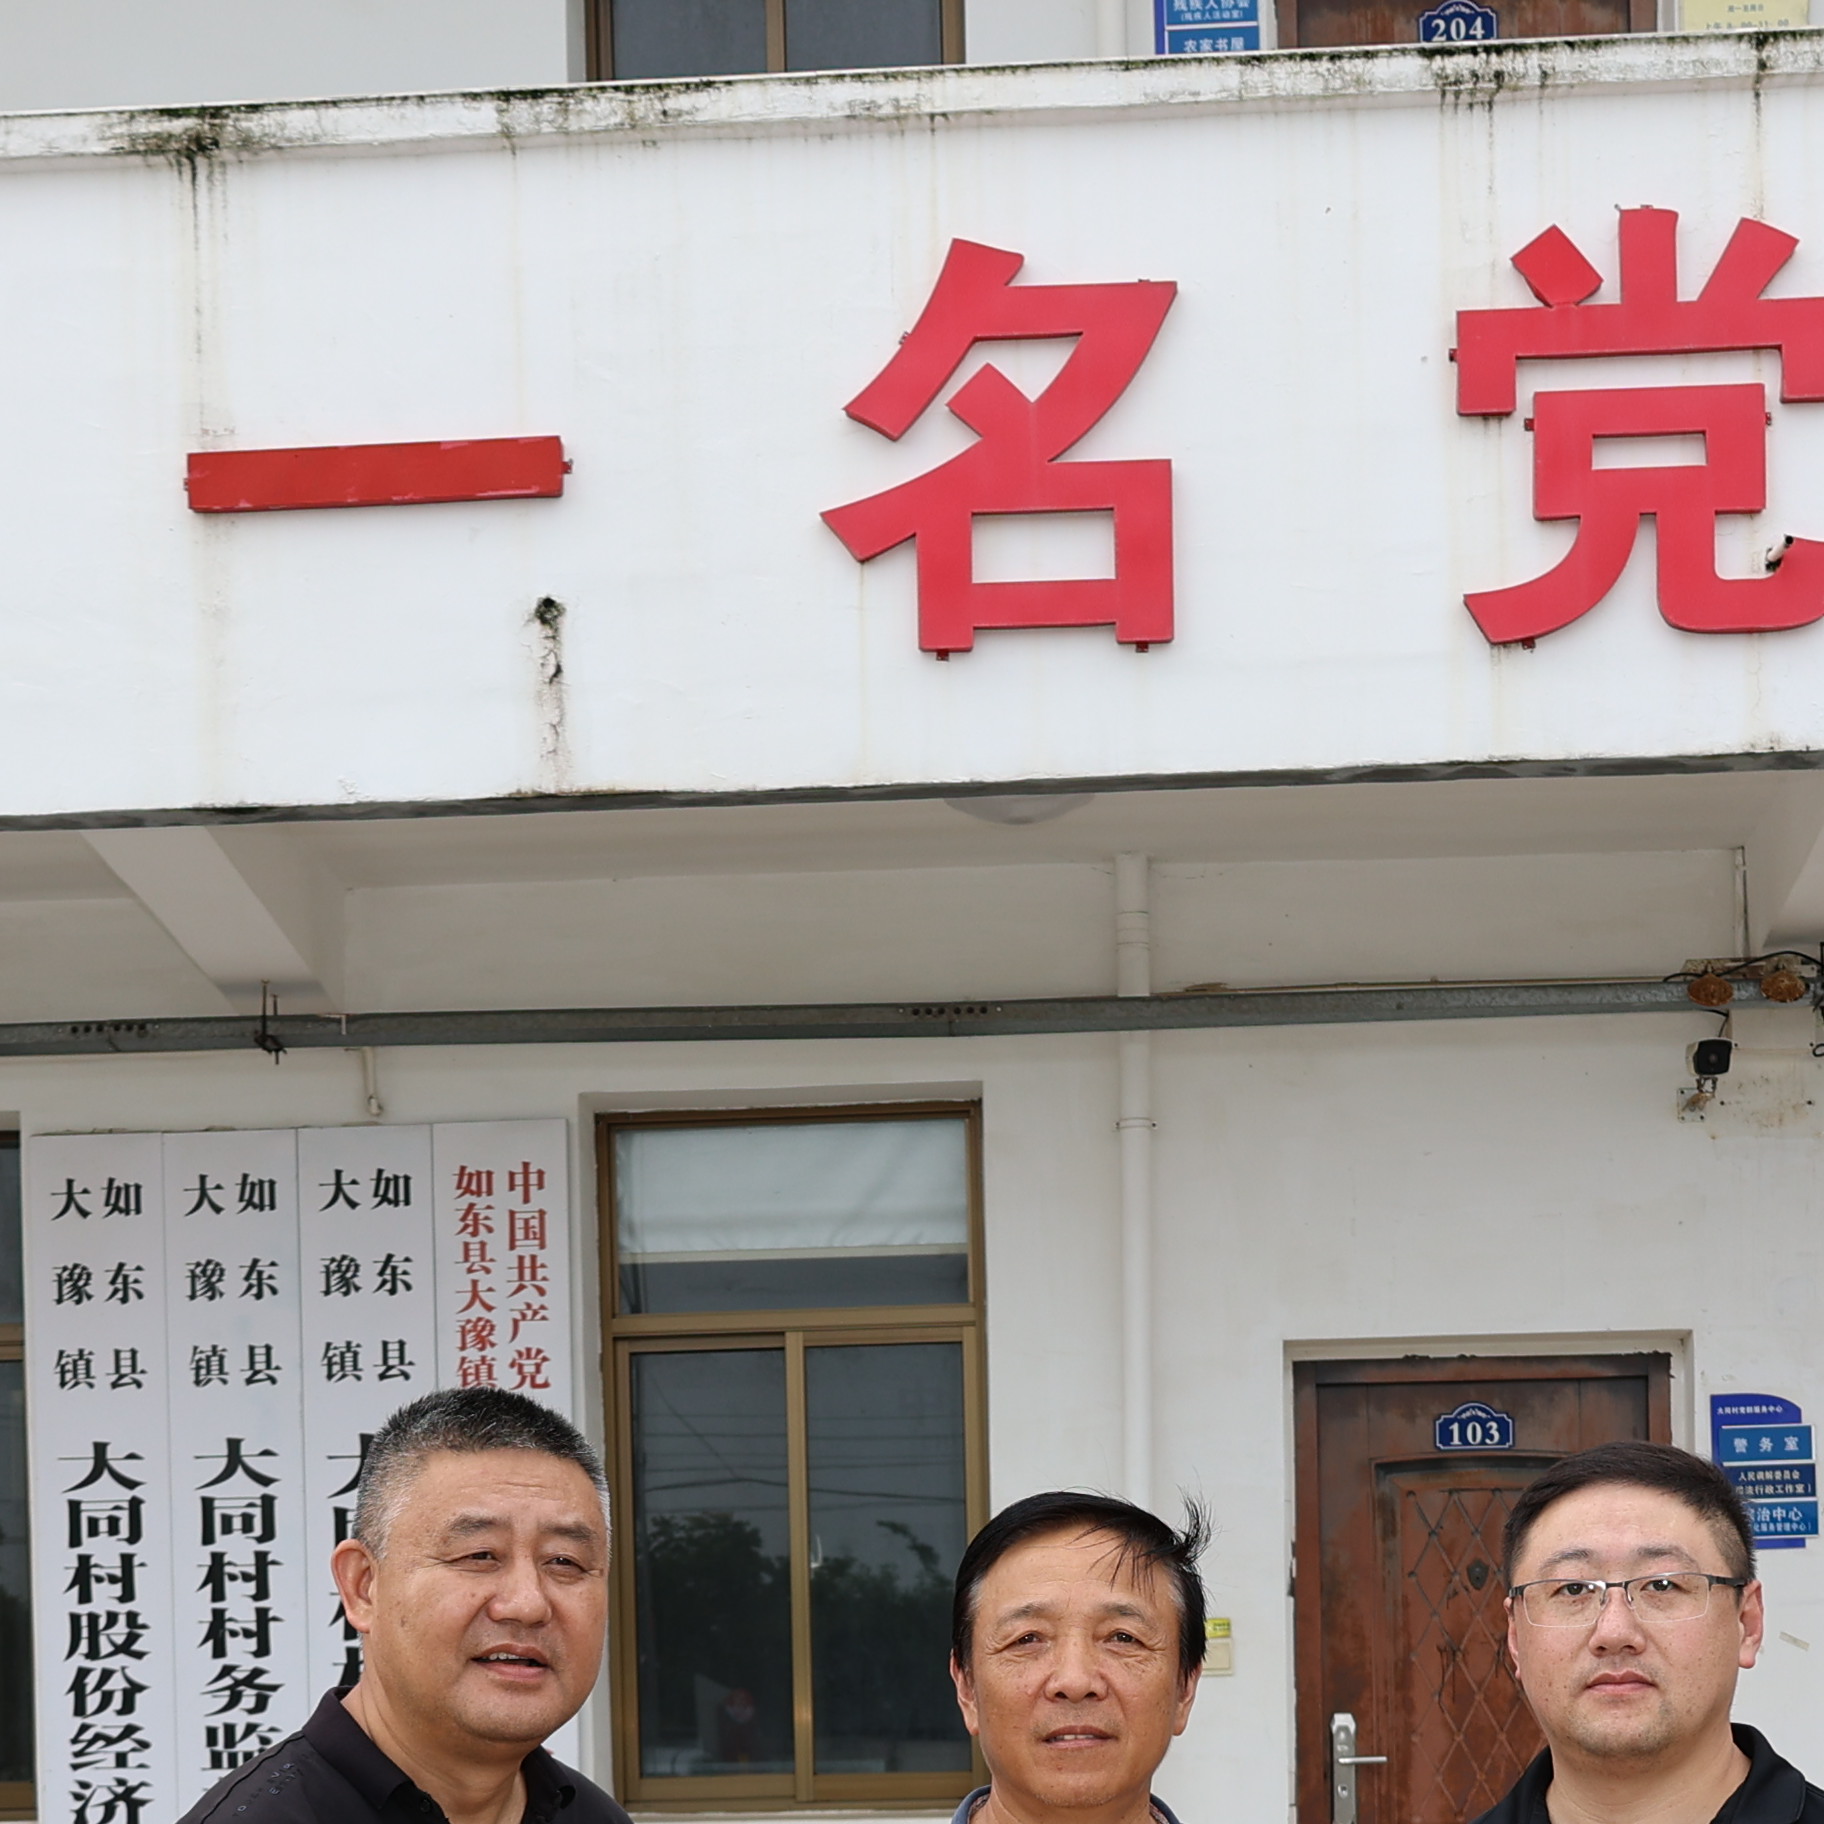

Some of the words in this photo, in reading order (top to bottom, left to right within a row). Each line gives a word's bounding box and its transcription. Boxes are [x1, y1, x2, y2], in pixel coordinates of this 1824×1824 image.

[1183, 37, 1244, 53] 农家书屋
[1431, 16, 1485, 42] 204
[50, 1178, 97, 1390] 大豫镇
[100, 1177, 149, 1390] 如东县
[183, 1174, 229, 1388] 大豫镇
[235, 1172, 283, 1388] 如东县
[318, 1169, 364, 1383] 大豫镇
[370, 1168, 416, 1382] 如东县
[453, 1165, 498, 1389] 如东县大豫镇
[507, 1161, 552, 1391] 中国共产党
[1449, 1421, 1500, 1445] 103
[1733, 1436, 1799, 1453] 警务室
[194, 1437, 285, 1790] 大同村村务监
